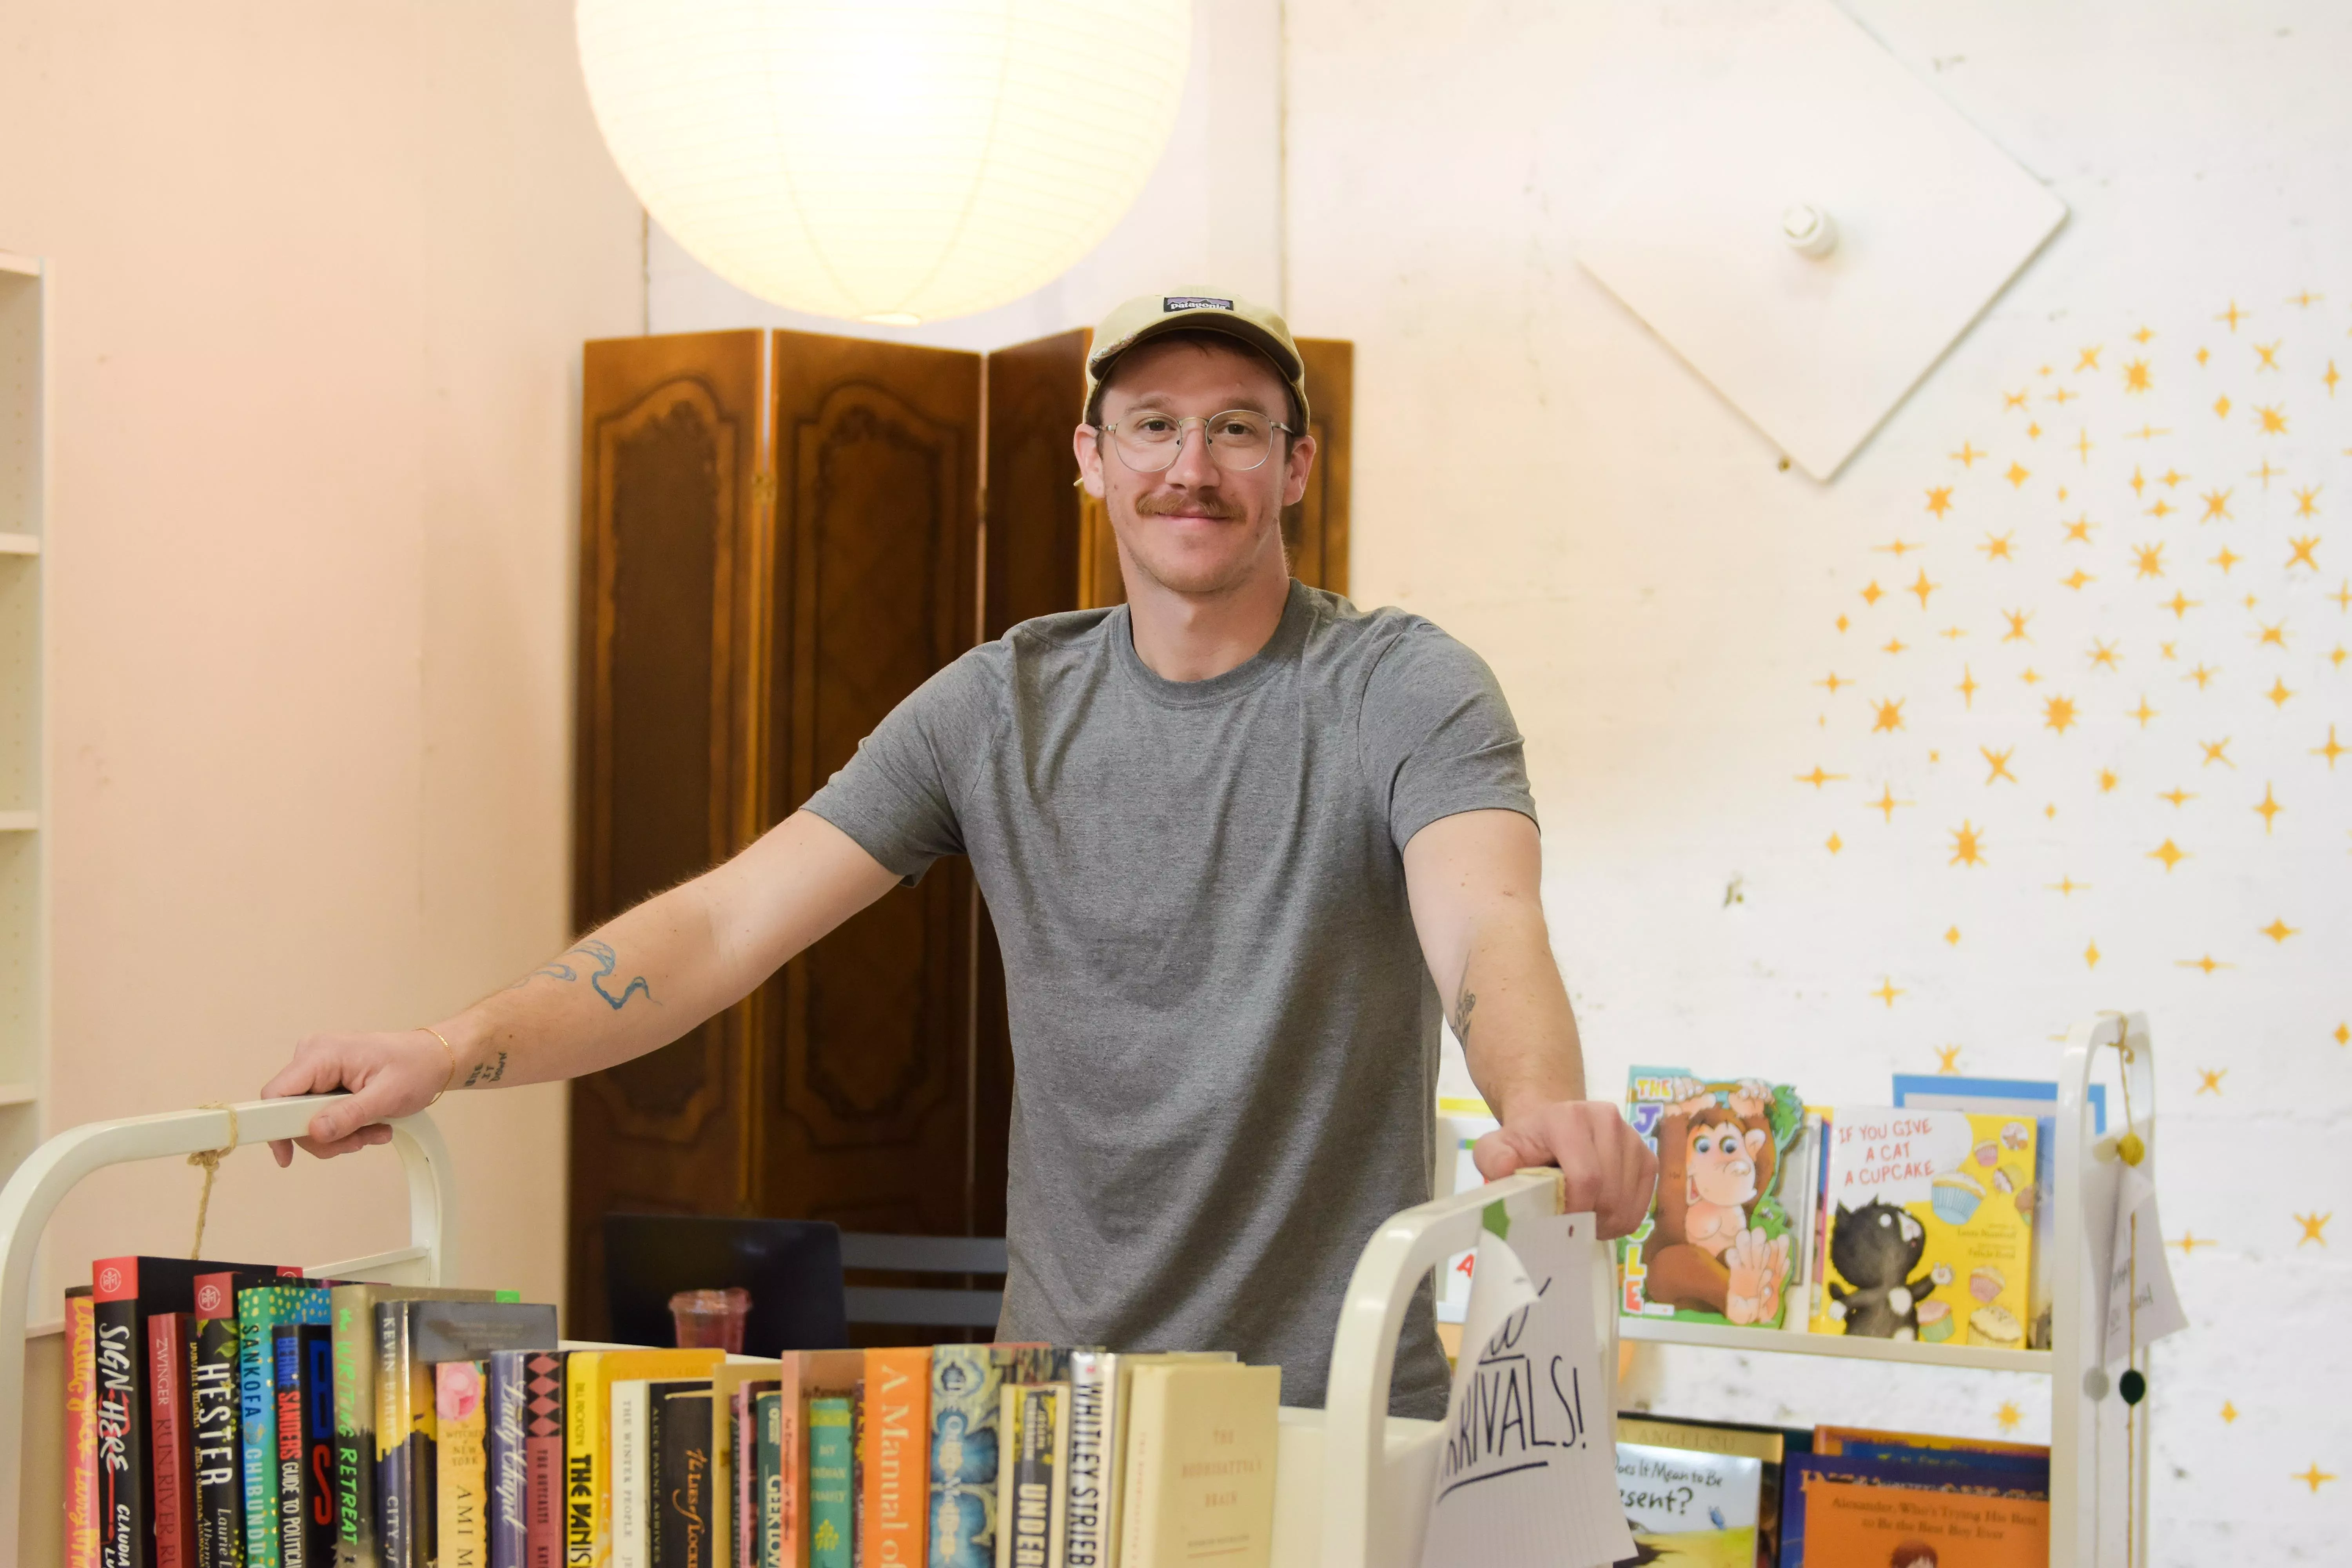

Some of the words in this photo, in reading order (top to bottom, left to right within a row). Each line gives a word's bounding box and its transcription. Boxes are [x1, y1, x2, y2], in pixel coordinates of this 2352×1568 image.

[1637, 1080, 1671, 1098] THE
[1839, 1127, 1854, 1144] IF
[1859, 1123, 1888, 1142] YOU
[1893, 1118, 1932, 1137] GIVE
[1866, 1147, 1875, 1161] A
[1881, 1142, 1911, 1161] CAT
[1845, 1171, 1854, 1186] A
[1859, 1161, 1935, 1185] CUPCAKE
[98, 1323, 133, 1392] SIGN
[243, 1324, 261, 1417] SANKOFA
[383, 1317, 395, 1371] KEVIN
[156, 1337, 169, 1406] ZWINGER
[336, 1341, 356, 1438] WRITING
[881, 1365, 909, 1393] A
[97, 1400, 129, 1473] HERE
[197, 1363, 233, 1486] HESTER
[278, 1391, 302, 1460] SANDERS
[494, 1379, 526, 1445] Lady
[623, 1400, 632, 1426] THE
[1073, 1382, 1103, 1479] WHITLEY
[156, 1419, 174, 1467] RUN,
[623, 1432, 632, 1484] WINTER
[880, 1404, 909, 1531] Manual
[281, 1462, 299, 1494] GUIDE
[339, 1447, 358, 1546] RETREAT
[495, 1449, 528, 1534] Chapel
[571, 1454, 592, 1497] THE
[1651, 1461, 1689, 1483] Mean
[1691, 1473, 1702, 1484] to
[1705, 1474, 1723, 1487] Be
[245, 1448, 264, 1554] CHIBUNDU
[283, 1499, 299, 1514] TO
[386, 1495, 399, 1539] CITY
[456, 1485, 474, 1535] AMI
[623, 1490, 632, 1537] PEOPLE
[766, 1474, 782, 1528] GEEK
[116, 1504, 131, 1567] CLAUDIA
[217, 1508, 232, 1555] Laurie
